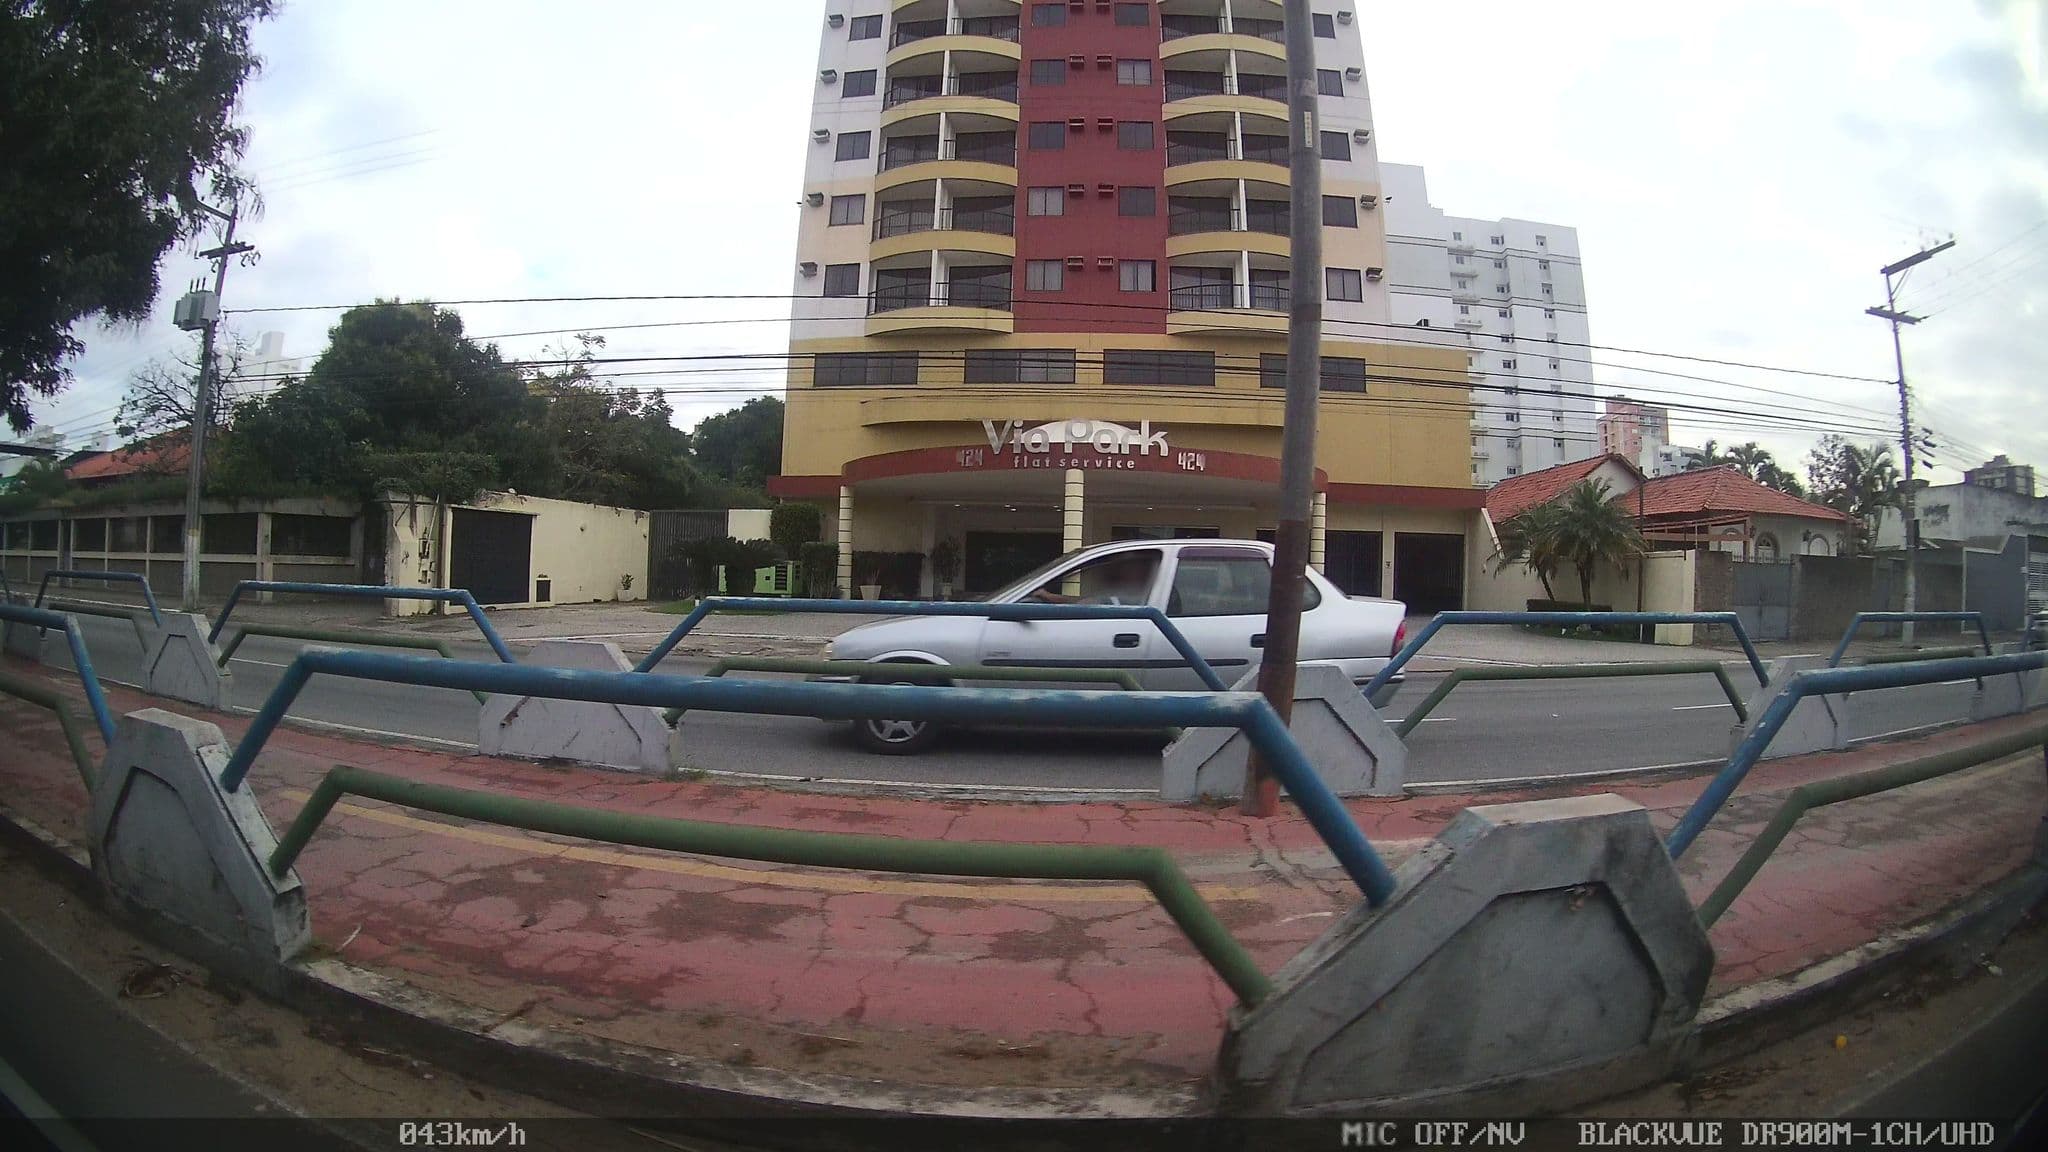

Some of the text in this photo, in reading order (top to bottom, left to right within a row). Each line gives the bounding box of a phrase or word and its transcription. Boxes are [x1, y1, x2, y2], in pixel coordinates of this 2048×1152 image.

[982, 418, 1169, 457] Via Park
[957, 448, 983, 467] 424
[1013, 455, 1135, 470] flat service
[1178, 451, 1205, 471] 424
